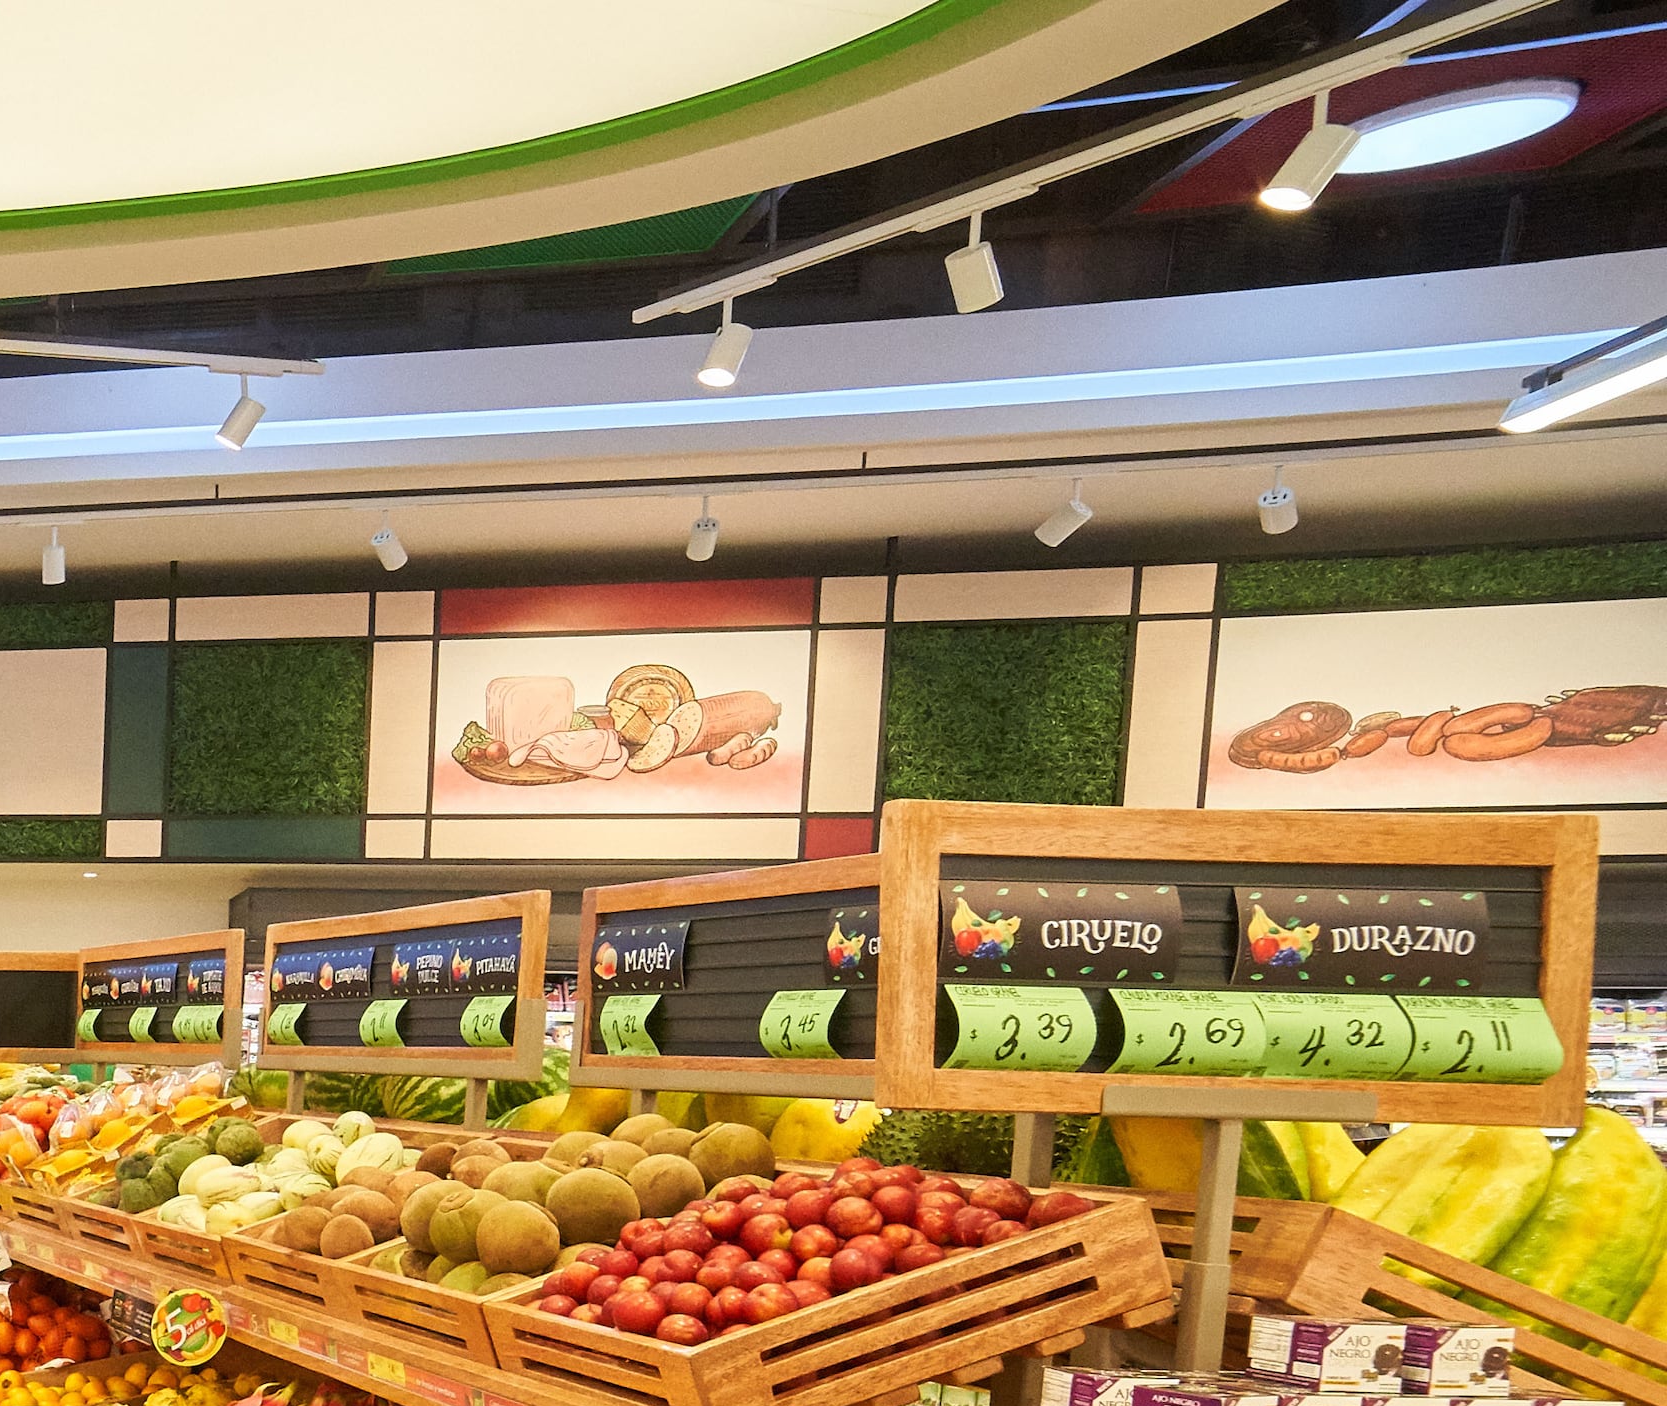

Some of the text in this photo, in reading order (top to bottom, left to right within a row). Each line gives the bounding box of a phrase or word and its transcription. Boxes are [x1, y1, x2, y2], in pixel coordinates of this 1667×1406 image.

[1041, 919, 1163, 955] CIRUELO
[1330, 925, 1476, 957] DURAZNO
[476, 955, 516, 976] PITAHAYA
[624, 942, 675, 973] MAMEY
[165, 1307, 187, 1350] 5
[187, 1323, 195, 1337] al
[1345, 1336, 1371, 1347] AJO
[1455, 1339, 1480, 1350] AJO
[1329, 1348, 1371, 1359] NEGRO
[1439, 1351, 1480, 1362] NEGRO
